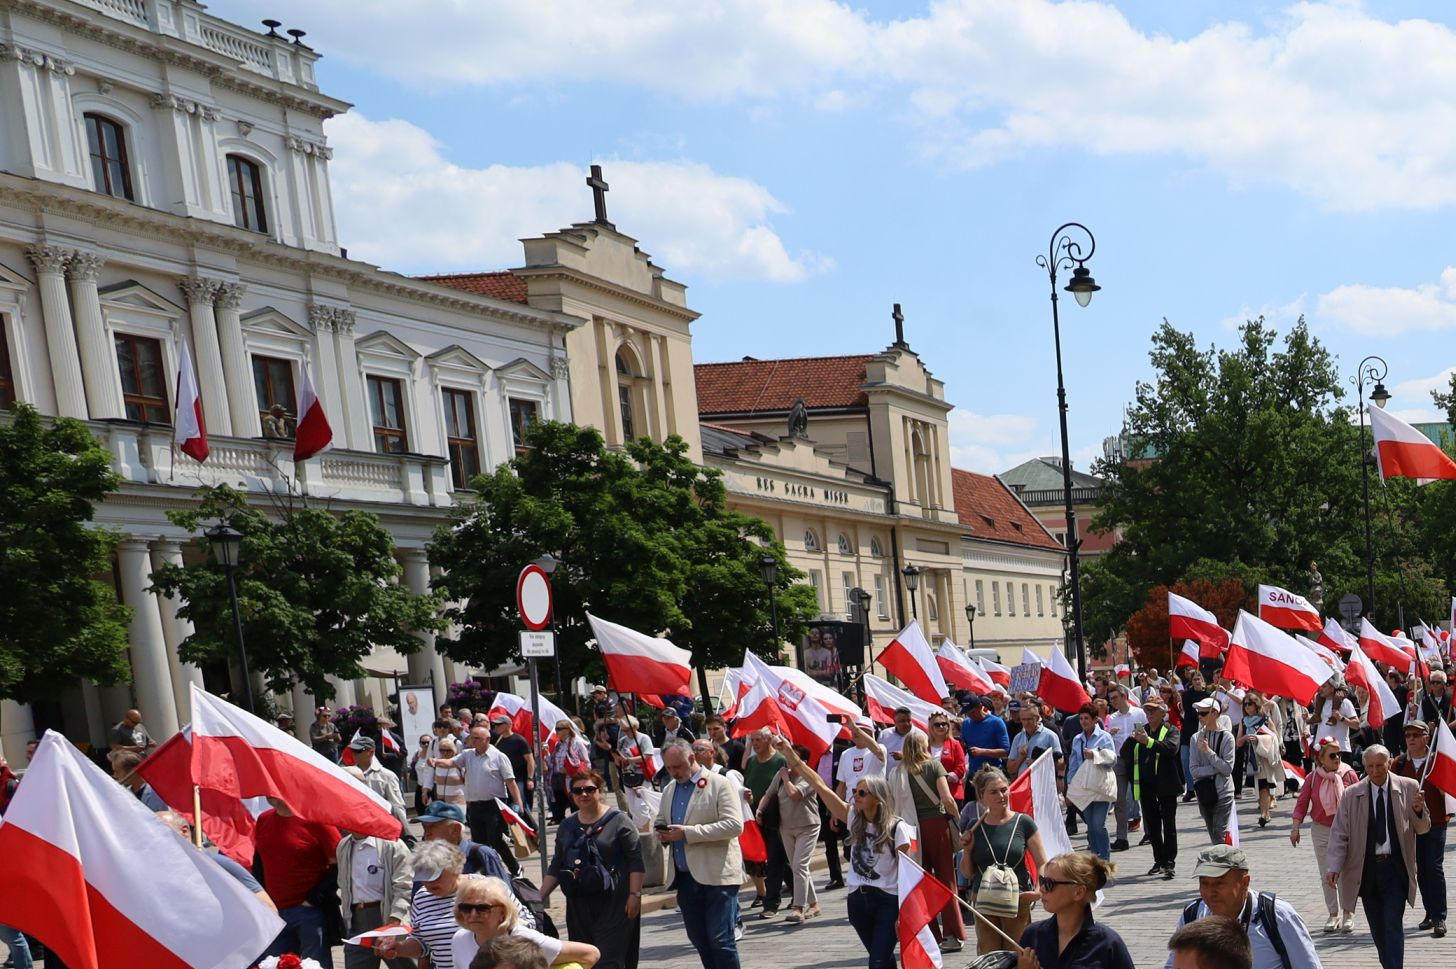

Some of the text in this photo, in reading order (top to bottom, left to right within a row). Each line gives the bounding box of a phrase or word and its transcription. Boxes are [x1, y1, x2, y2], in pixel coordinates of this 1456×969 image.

[757, 477, 848, 504] RES SACRA MISER
